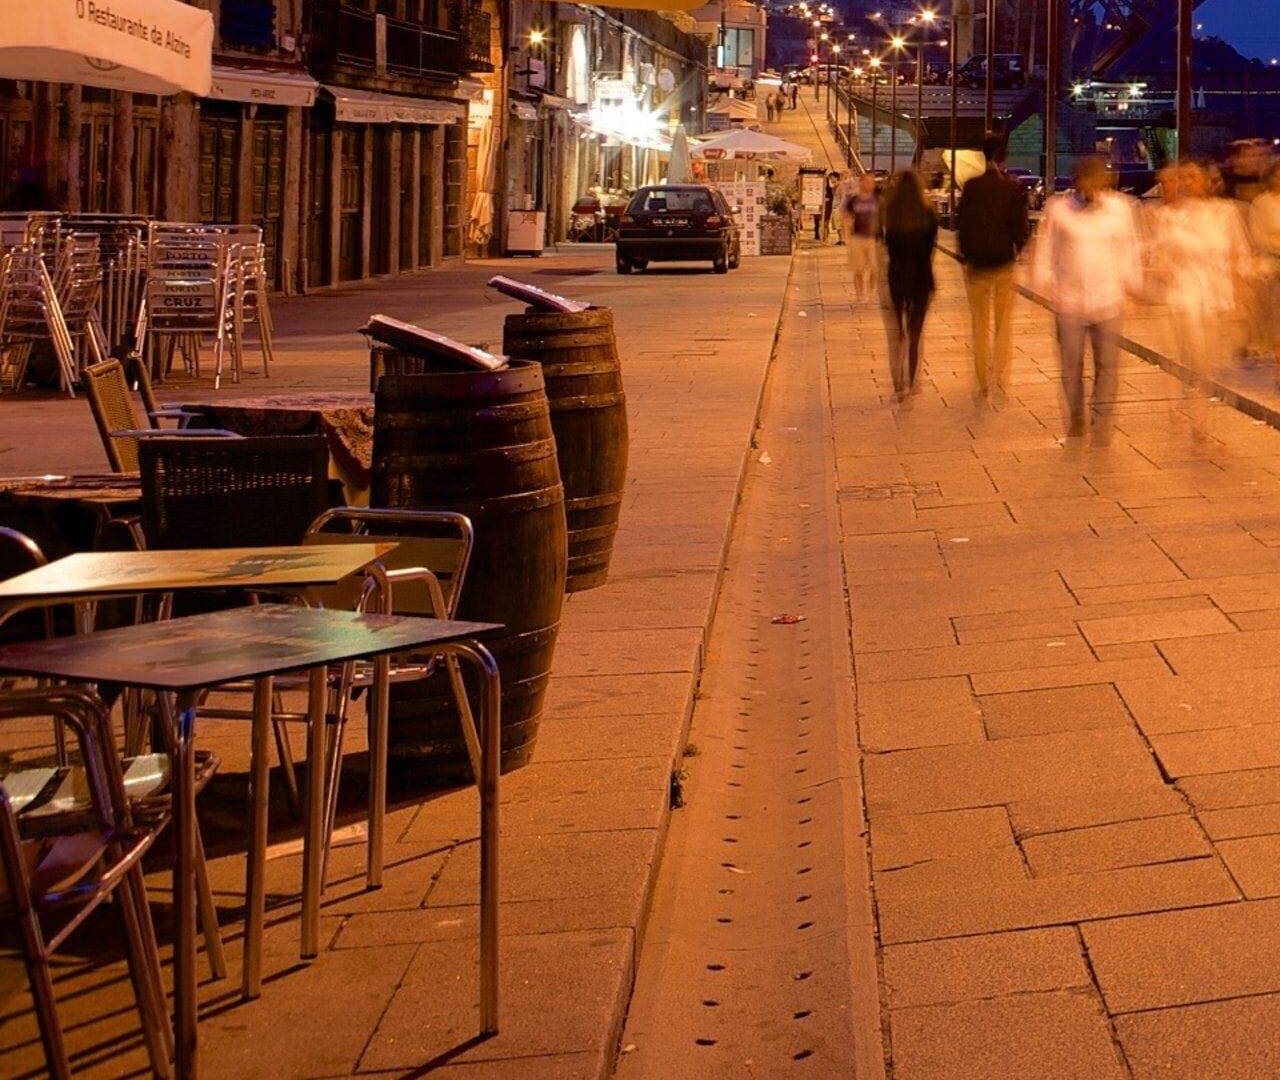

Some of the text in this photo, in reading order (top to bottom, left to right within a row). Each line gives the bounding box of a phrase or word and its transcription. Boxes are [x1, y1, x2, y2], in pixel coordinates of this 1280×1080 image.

[88, 1, 148, 41] Restaurante
[151, 25, 162, 46] da
[165, 30, 192, 59] Alzira
[163, 298, 203, 307] CRUZ
